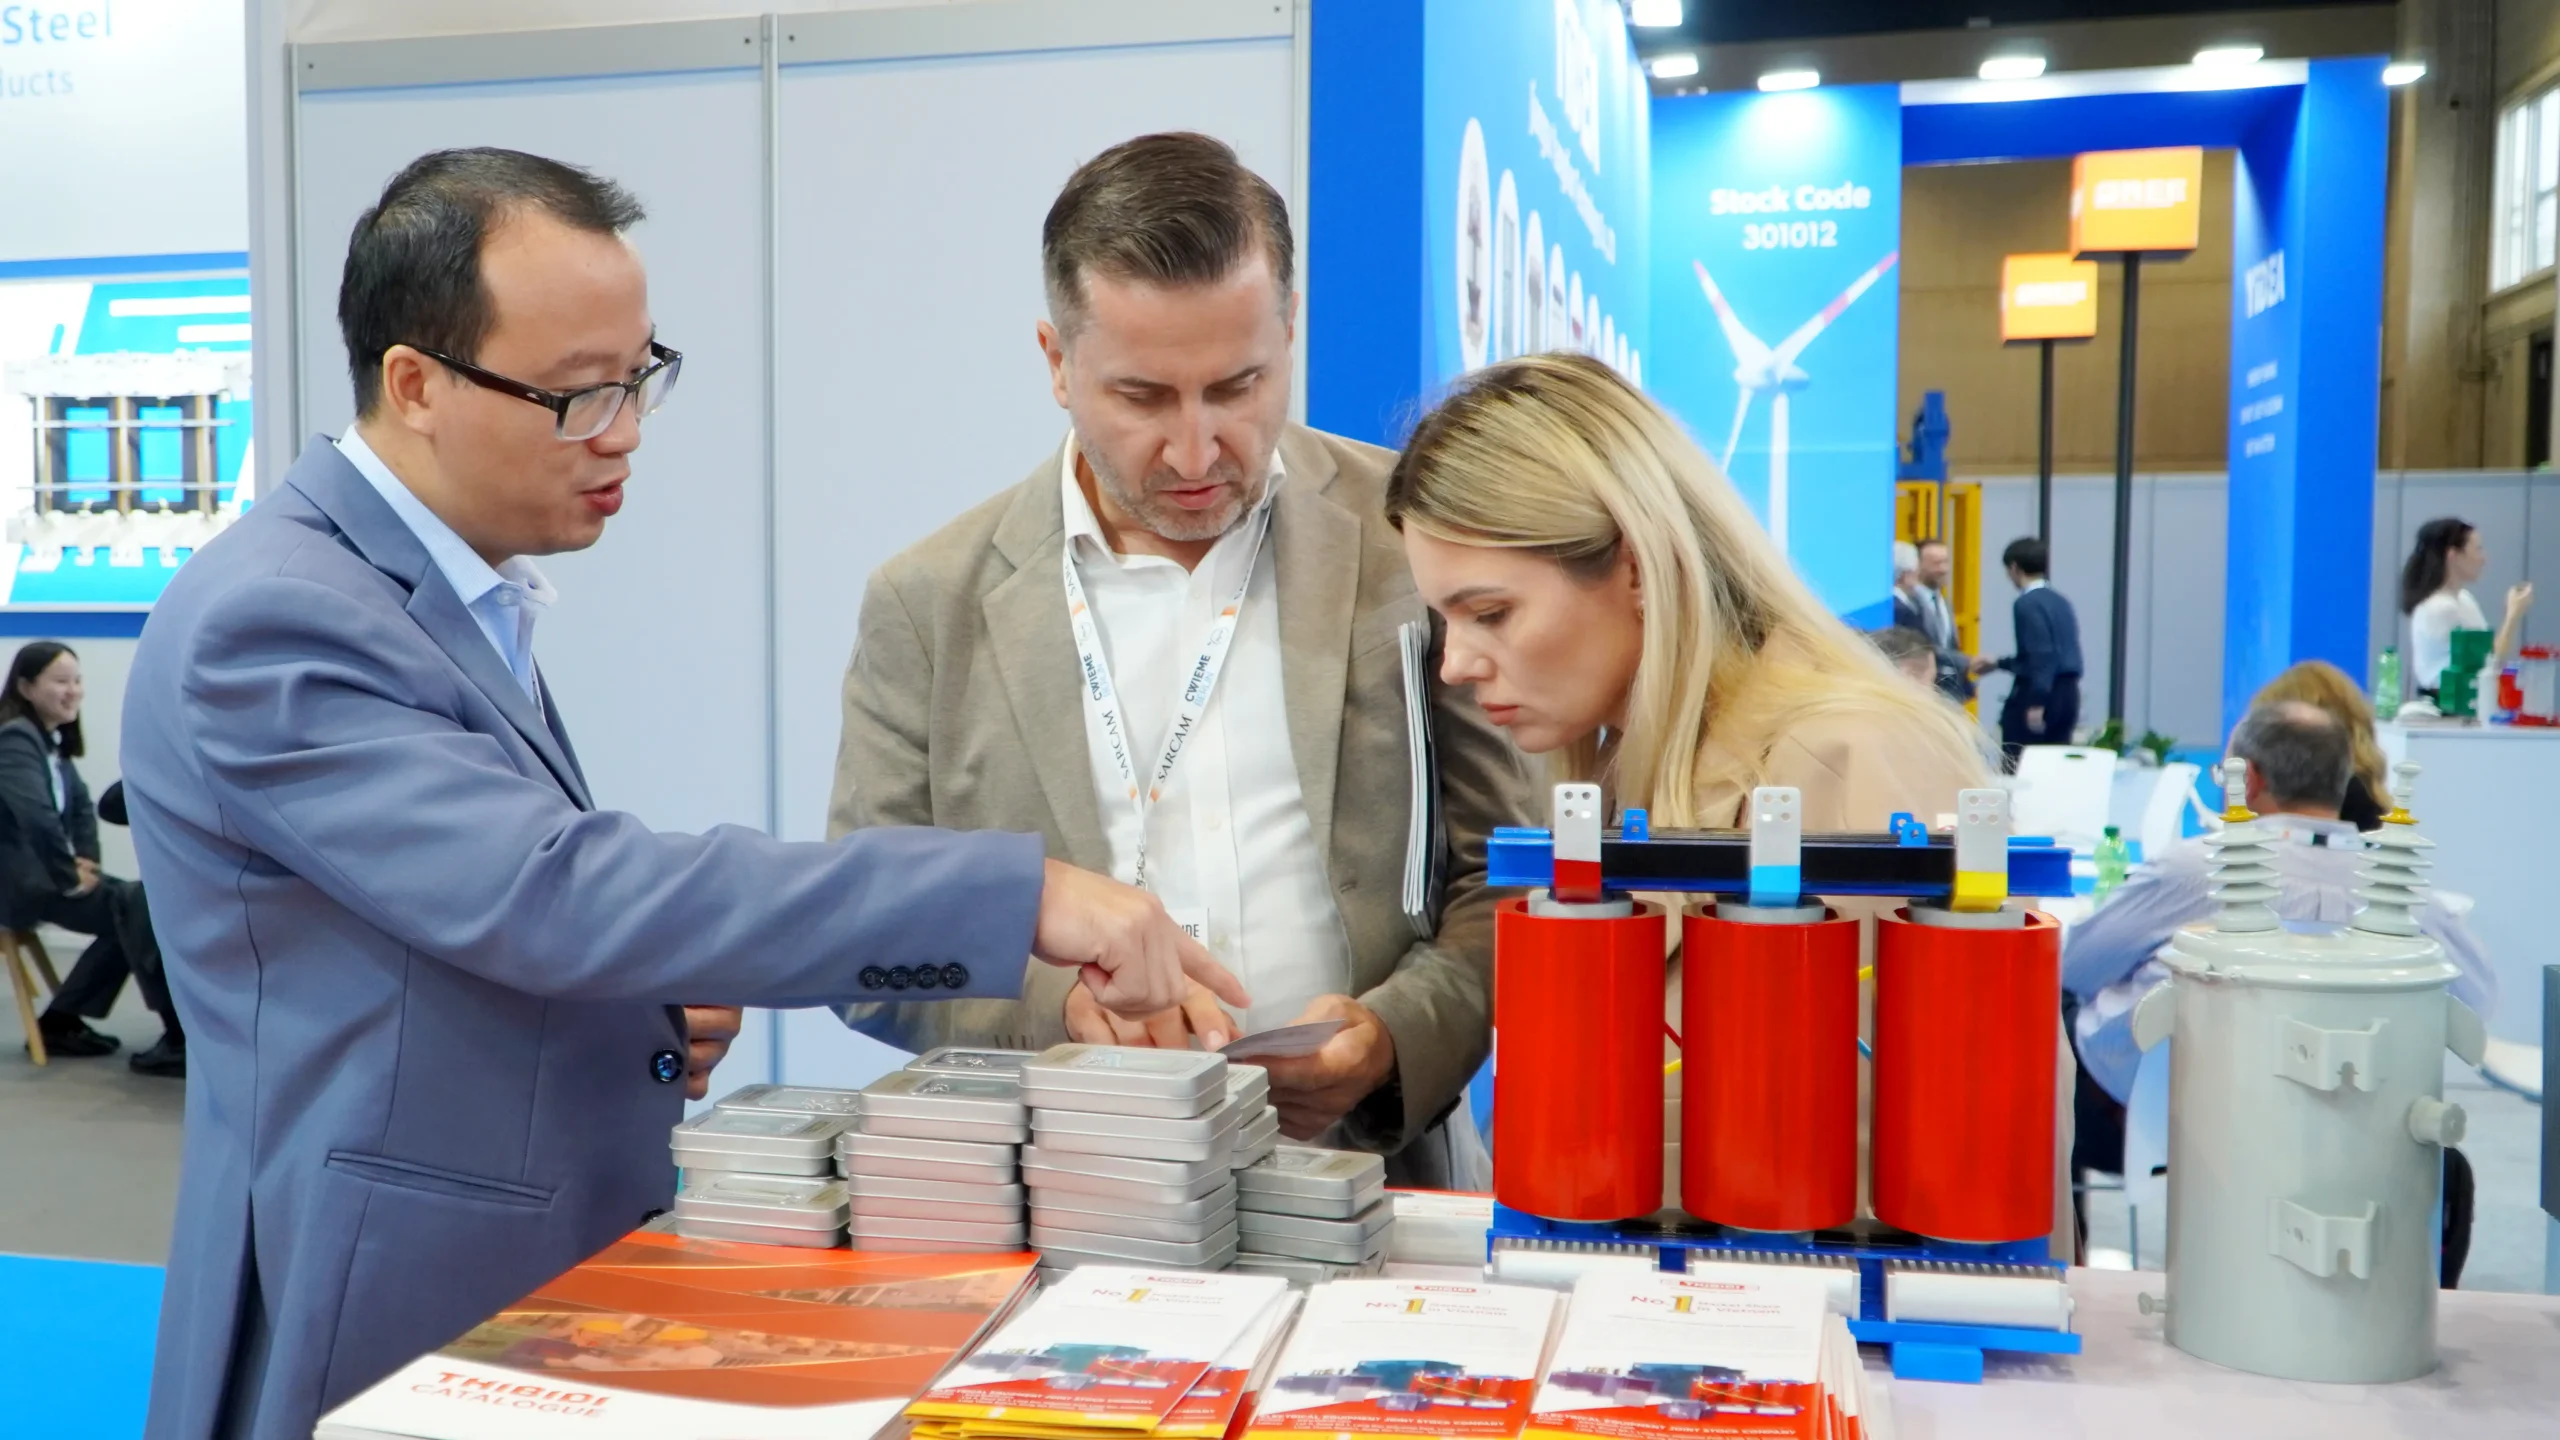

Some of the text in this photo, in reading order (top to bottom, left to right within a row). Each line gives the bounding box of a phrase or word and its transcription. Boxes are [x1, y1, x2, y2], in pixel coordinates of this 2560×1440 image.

[2, 0, 112, 45] Steel
[1710, 179, 1872, 215] Stock Code
[1742, 219, 1839, 250] 301012
[1083, 652, 1103, 701] CWIEME
[1184, 653, 1211, 703] CWIEME
[1101, 709, 1131, 780] SARCAM
[1157, 713, 1193, 784] SARCAM
[1667, 1295, 1697, 1314] 1
[410, 1383, 607, 1417] CATALOGUE
[438, 1371, 611, 1406] THIBIDI
